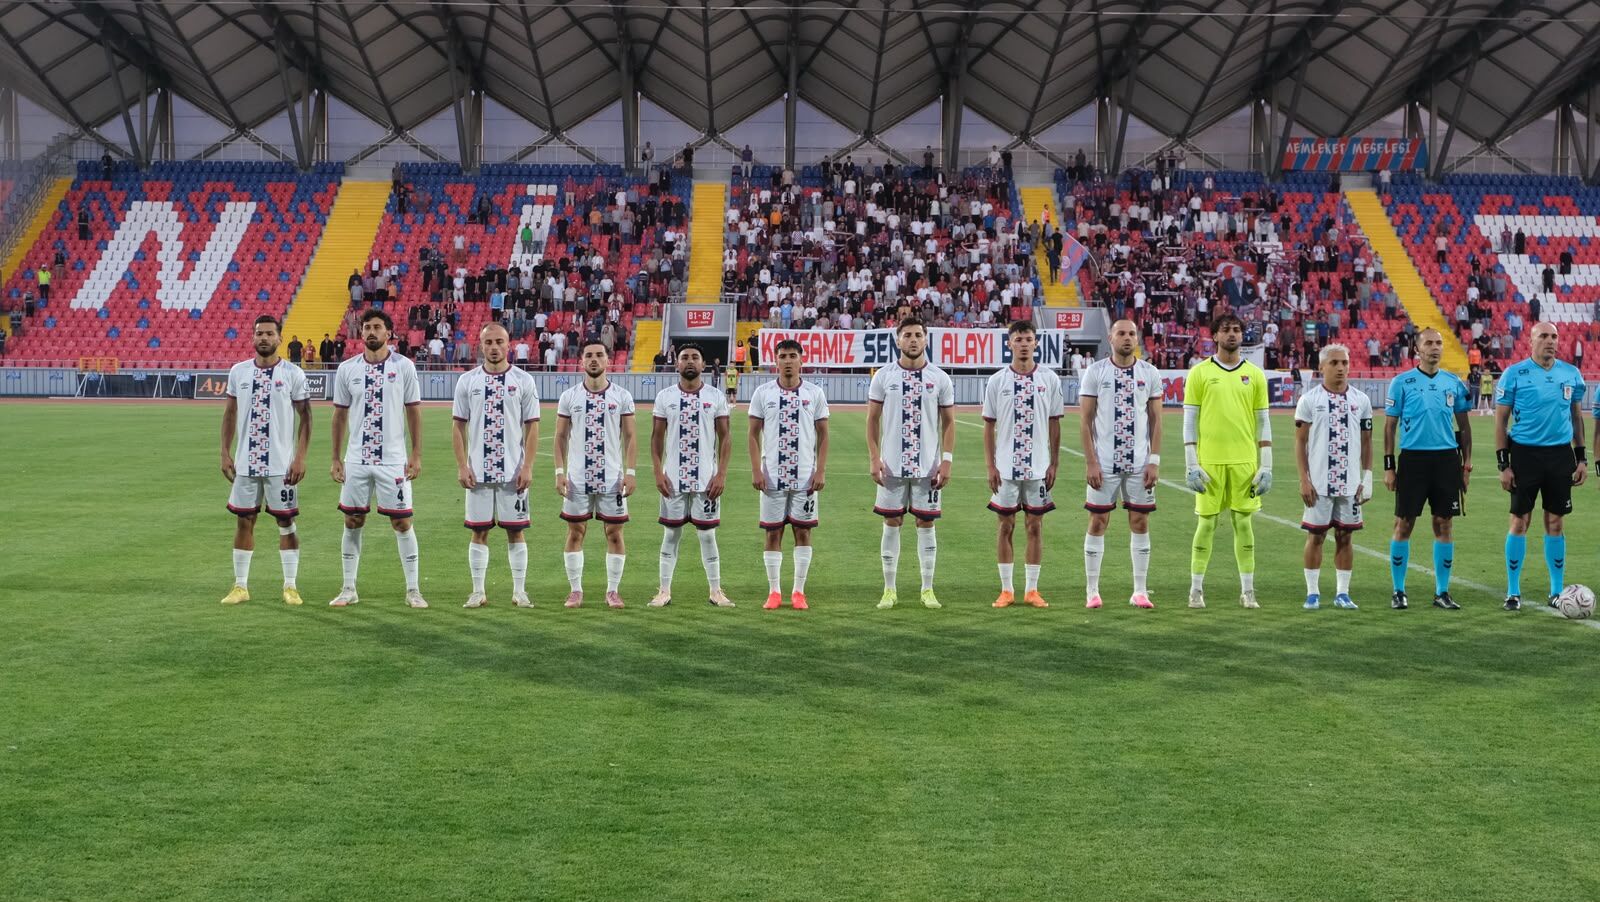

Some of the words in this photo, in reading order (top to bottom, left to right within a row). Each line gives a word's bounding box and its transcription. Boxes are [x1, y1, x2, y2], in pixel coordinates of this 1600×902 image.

[942, 332, 993, 363] ALAYI
[281, 489, 294, 502] 99
[397, 489, 404, 501] 4
[928, 490, 938, 503] 18
[514, 499, 526, 512] 41
[803, 500, 815, 513] 42
